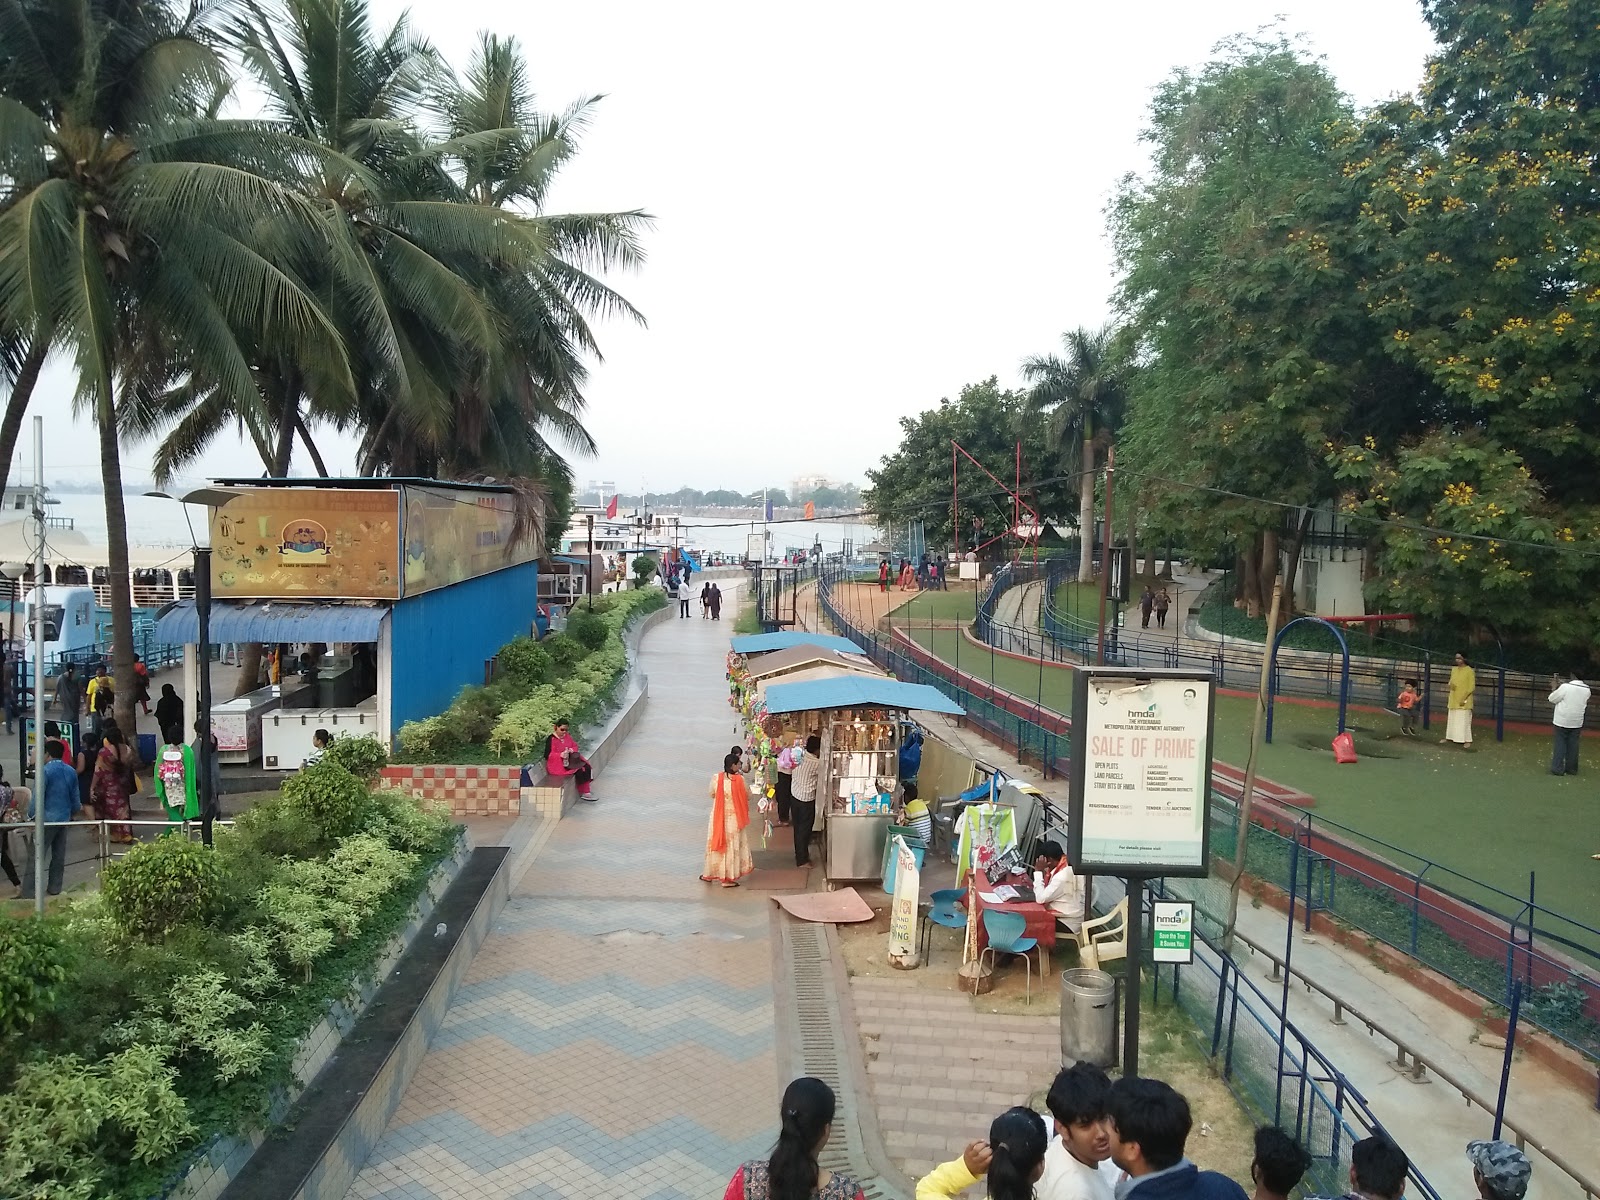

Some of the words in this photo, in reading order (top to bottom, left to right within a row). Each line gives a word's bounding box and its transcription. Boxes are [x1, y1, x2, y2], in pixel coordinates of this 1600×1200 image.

[1127, 710, 1155, 718] hmda
[1091, 735, 1125, 757] SALE
[1131, 737, 1148, 758] OF
[1154, 737, 1196, 759] PRIME
[1105, 772, 1124, 780] PARCELS
[1107, 782, 1117, 790] BITS
[1156, 915, 1182, 923] hmda
